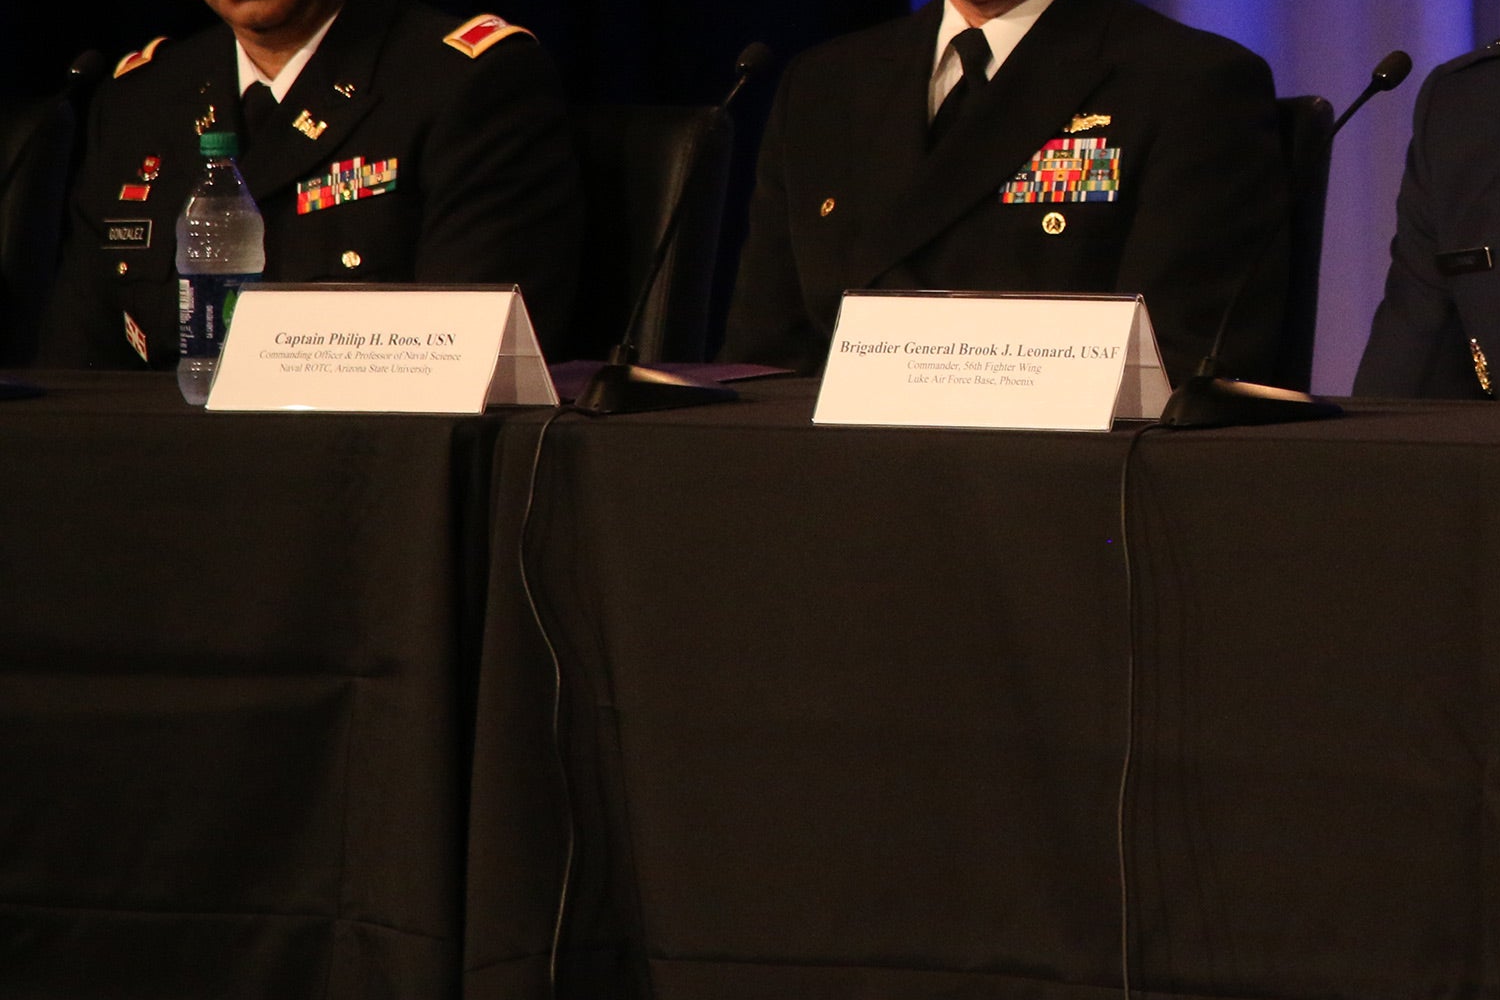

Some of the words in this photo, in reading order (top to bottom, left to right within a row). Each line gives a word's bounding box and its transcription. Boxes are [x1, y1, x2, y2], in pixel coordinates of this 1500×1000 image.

[109, 227, 144, 241] GONZALEZ
[275, 332, 325, 348] Captain
[328, 332, 366, 349] Philip
[369, 333, 383, 346] H.
[388, 333, 421, 347] Roos,
[427, 333, 456, 346] USN
[259, 350, 312, 361] Commanding
[314, 350, 343, 360] Officer
[344, 351, 354, 360] &
[355, 351, 392, 360] Professor
[393, 351, 405, 360] of
[405, 351, 429, 360] Naval
[430, 352, 462, 361] Science
[840, 341, 901, 356] Brigadier
[904, 341, 956, 355] General
[959, 343, 998, 356] Brook
[1001, 344, 1013, 356] J.
[1017, 344, 1075, 359] Leonard,
[1081, 346, 1120, 359] USAF
[280, 363, 303, 373] Naval
[304, 363, 333, 373] ROTC,
[334, 363, 367, 373] Arizona
[368, 364, 389, 373] State
[390, 364, 431, 375] University
[907, 360, 961, 371] Commander,
[964, 361, 983, 371] 56th
[984, 361, 1016, 374] Fighter
[1018, 363, 1043, 375] Wing
[908, 374, 930, 384] Luke
[931, 374, 946, 384] Air
[947, 375, 972, 384] Force
[974, 375, 997, 386] Base,
[999, 376, 1035, 387] Phoenix
